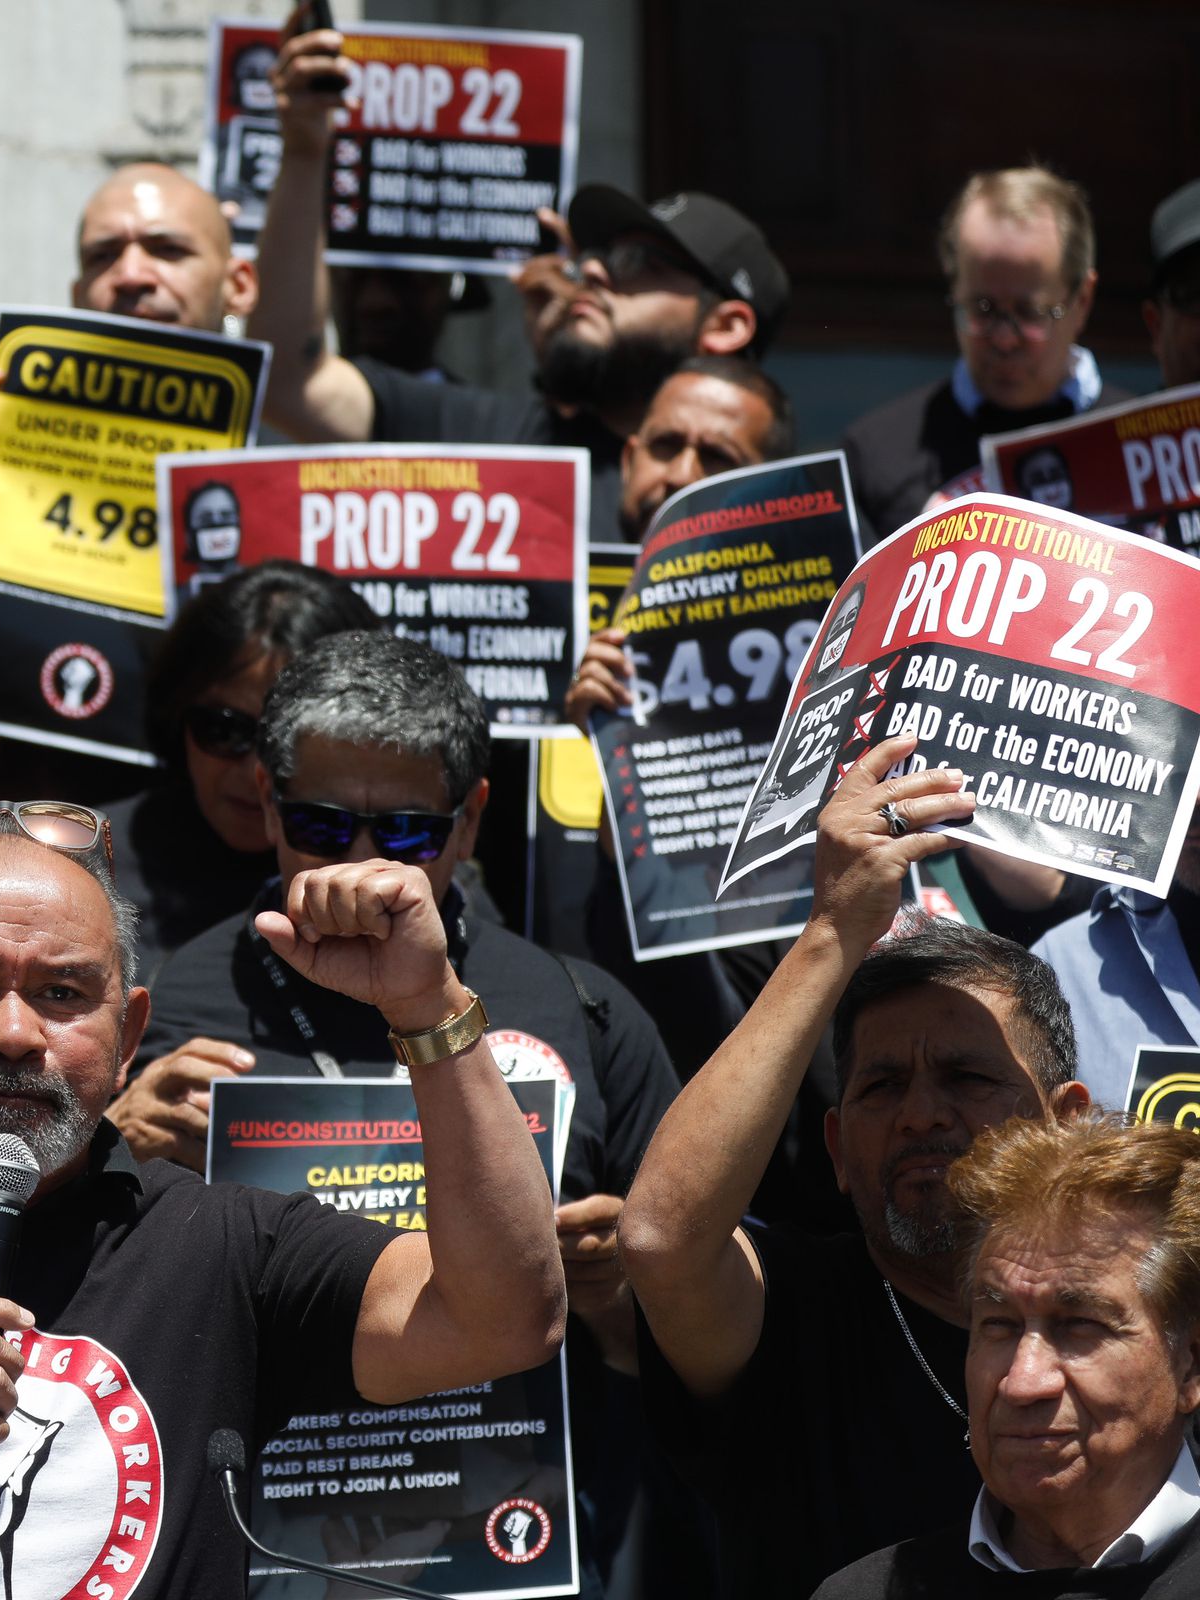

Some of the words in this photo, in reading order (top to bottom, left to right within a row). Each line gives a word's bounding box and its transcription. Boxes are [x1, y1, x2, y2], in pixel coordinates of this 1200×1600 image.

[460, 67, 522, 137] 22
[20, 351, 219, 420] CAUTION
[17, 414, 99, 441] UNDER
[299, 460, 483, 492] UNCONSTITUTIONAL
[1122, 427, 1200, 511] PRO
[43, 492, 158, 549] 4.98
[300, 490, 439, 570] PROP
[451, 491, 521, 572] 22
[649, 542, 775, 582] CALIFORNIA
[913, 511, 1116, 576] UNCONSTITUTIONAL
[394, 581, 429, 617] for
[430, 583, 530, 620] WORKERS
[641, 570, 740, 607] DELIVERY
[742, 556, 833, 589] DRIVERS
[687, 601, 726, 624] NET
[881, 550, 1048, 648] PROP
[1049, 577, 1154, 679] 22
[468, 625, 566, 661] ECONOMY
[795, 687, 855, 739] PROP
[901, 655, 958, 694] BAD
[959, 664, 1004, 704] for
[1008, 673, 1137, 736] WORKERS
[632, 741, 667, 759] PAID
[703, 728, 742, 749] DAYS
[788, 722, 841, 777] 22:
[886, 702, 943, 741] BAD
[944, 712, 989, 753] for
[993, 724, 1038, 766] the
[1040, 735, 1175, 796] ECONOMY
[975, 771, 1134, 839] CALIFORNIA
[648, 817, 682, 835] PAID
[651, 833, 694, 855] RIGHT
[694, 829, 717, 848] TO
[290, 1006, 316, 1040] UBER
[307, 1163, 426, 1187] CALIFORN
[315, 1187, 412, 1212] ELIVERY
[287, 1413, 343, 1431] RKERS'
[348, 1402, 483, 1426] COMPENSATION
[262, 1438, 323, 1455] SOCIAL
[326, 1432, 405, 1451] SECURITY
[409, 1419, 547, 1444] CONTRIBUTIONS
[85, 1359, 154, 1600] WORKERS
[262, 1460, 303, 1477] PAID
[306, 1458, 345, 1473] REST
[349, 1452, 415, 1470] BREAKS
[263, 1480, 314, 1500] RIGHT
[317, 1480, 340, 1497] TO
[343, 1476, 385, 1494] JOIN
[388, 1475, 402, 1490] A
[404, 1472, 461, 1490] UNION
